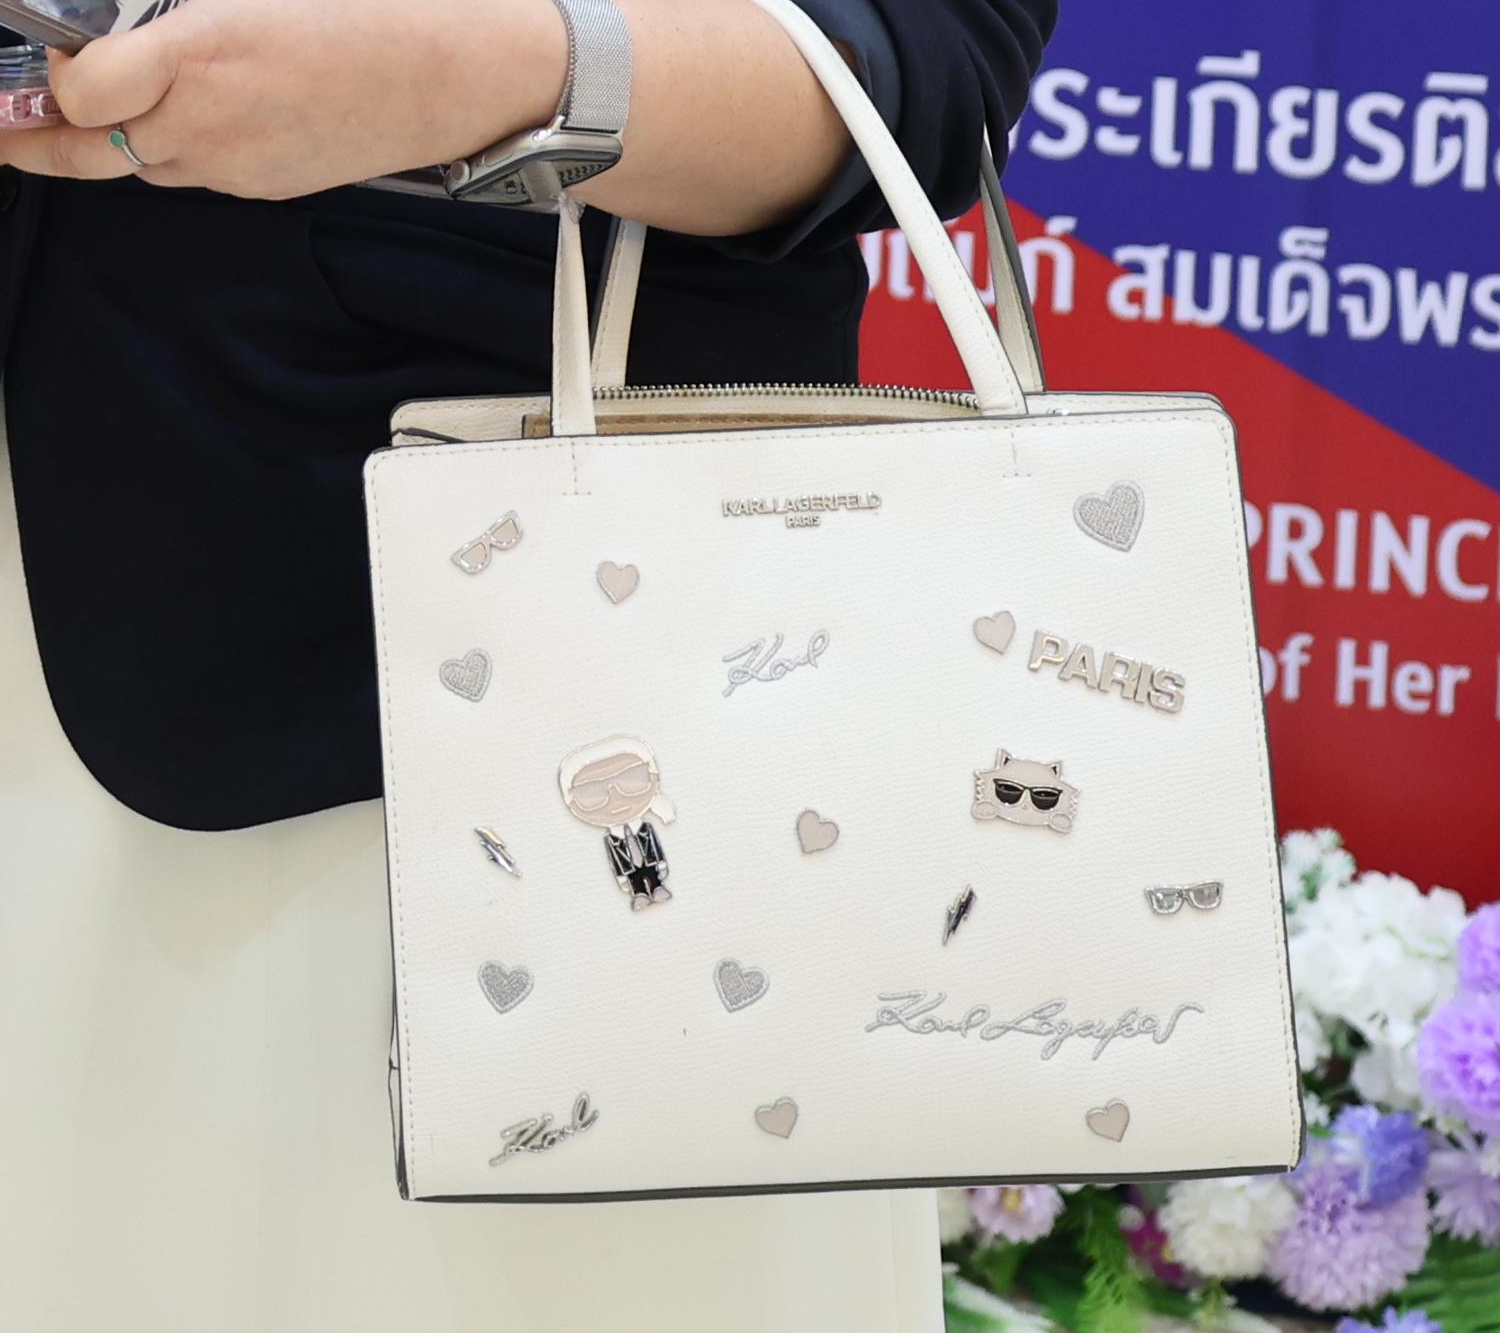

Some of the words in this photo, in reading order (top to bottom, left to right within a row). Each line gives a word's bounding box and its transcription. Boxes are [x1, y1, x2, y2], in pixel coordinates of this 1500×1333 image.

[722, 497, 773, 517] KARL
[774, 490, 882, 515] LAGERFELD
[785, 514, 822, 529] PARIS
[1027, 629, 1187, 715] PARIS
[1335, 638, 1471, 715] Her
